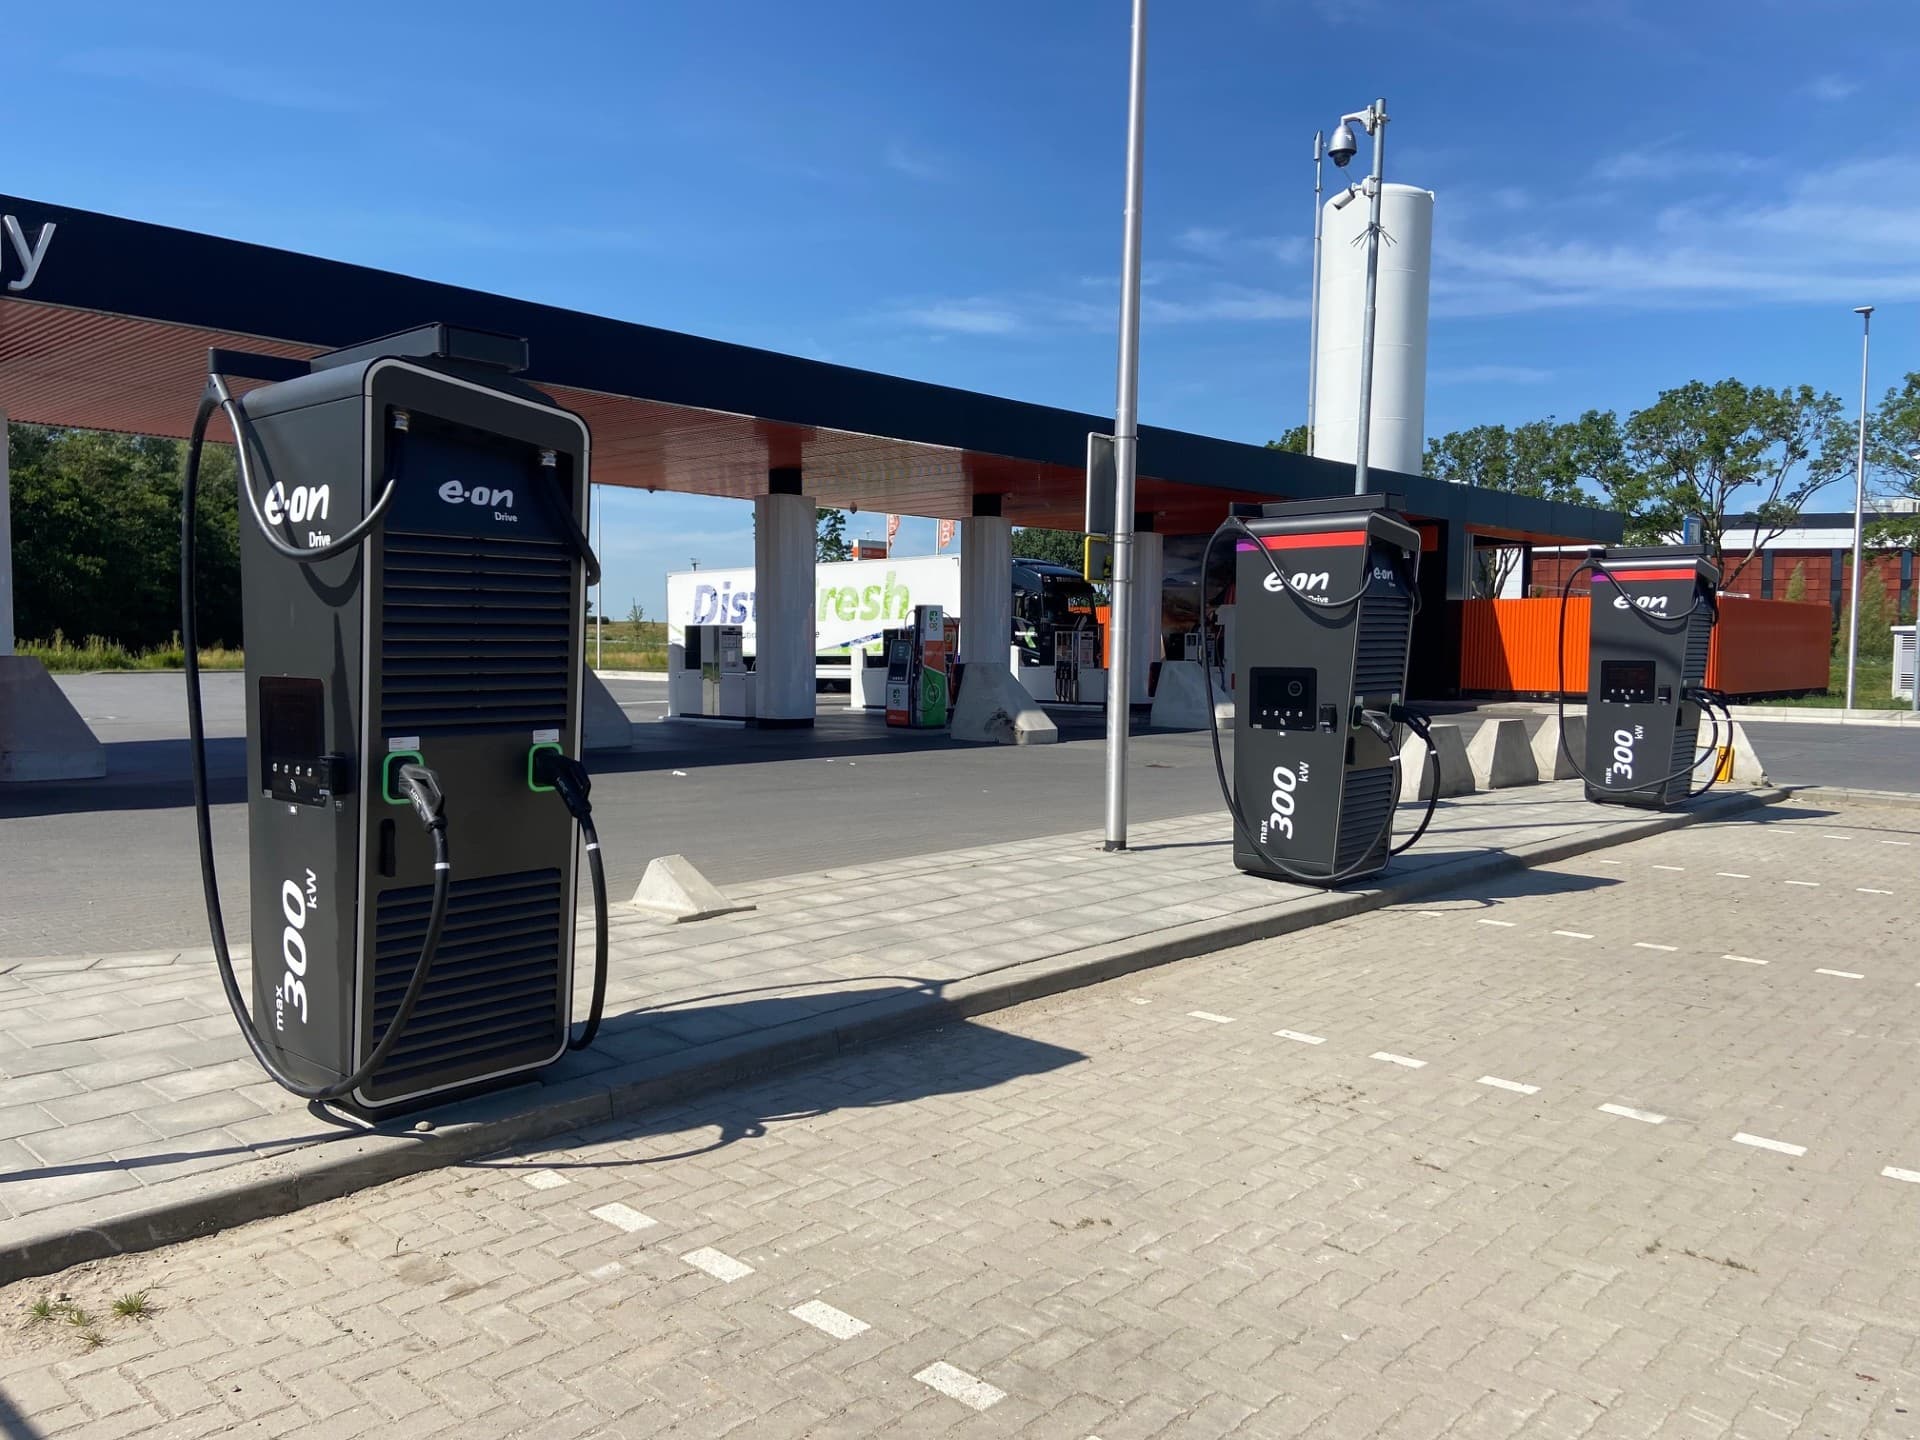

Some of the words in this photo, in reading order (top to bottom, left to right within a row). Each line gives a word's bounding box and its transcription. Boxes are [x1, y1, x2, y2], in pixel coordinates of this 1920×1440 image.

[308, 531, 331, 548] Drive
[494, 511, 518, 522] Drive
[816, 570, 910, 623] resh
[1613, 593, 1668, 609] eon
[1613, 729, 1633, 780] 300
[1635, 724, 1645, 740] kW
[1260, 820, 1268, 844] max
[1270, 766, 1297, 840] 300
[1298, 761, 1310, 782] kW
[276, 985, 284, 1031] max
[282, 879, 307, 1024] 300
[306, 868, 317, 909] kW
